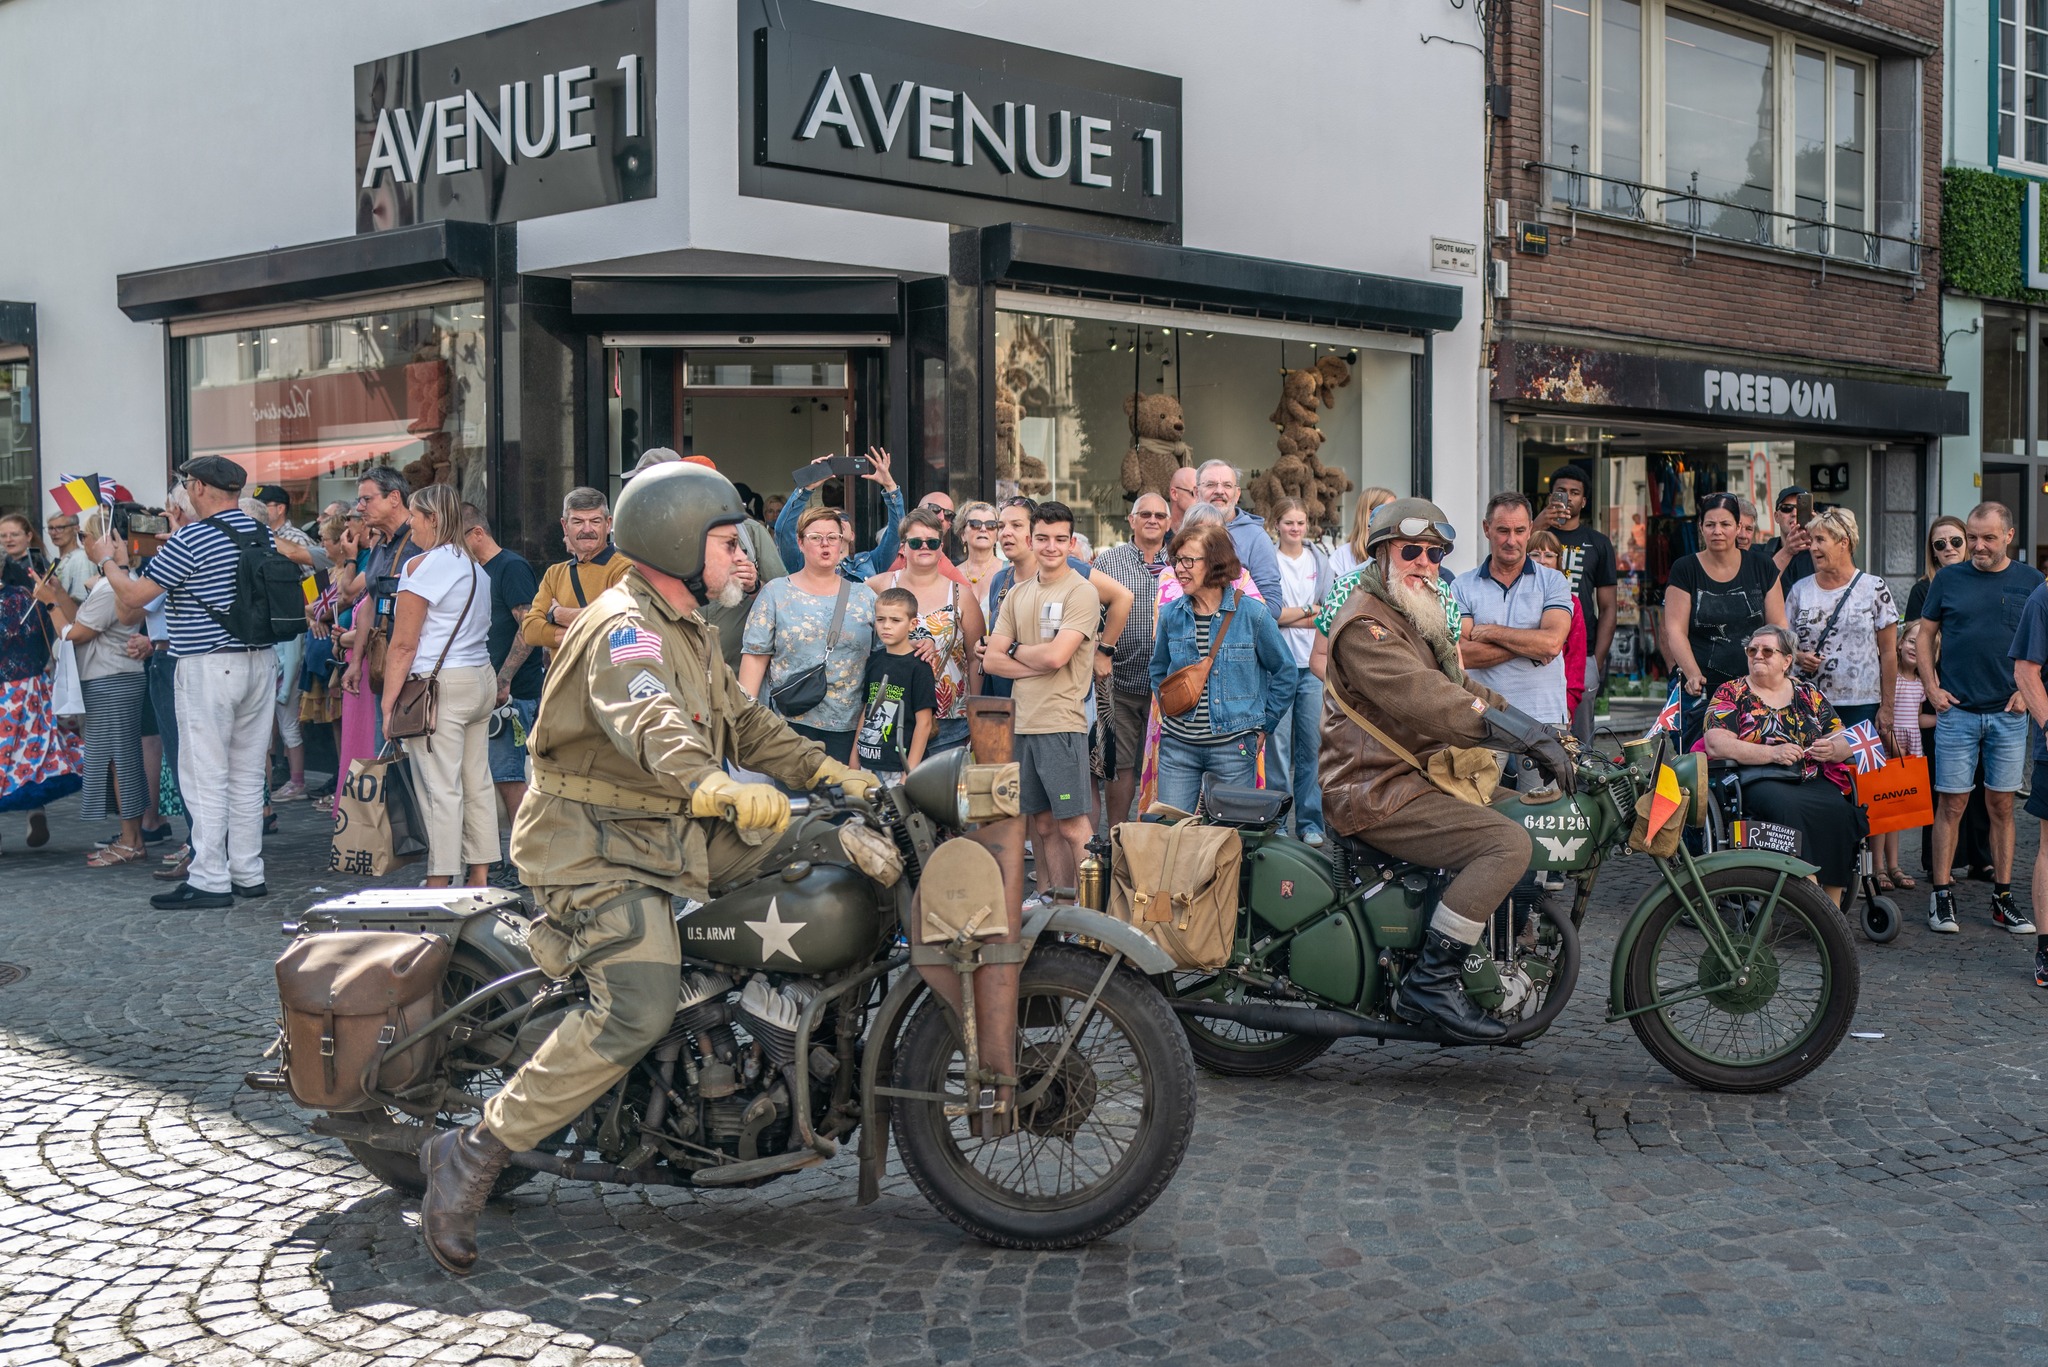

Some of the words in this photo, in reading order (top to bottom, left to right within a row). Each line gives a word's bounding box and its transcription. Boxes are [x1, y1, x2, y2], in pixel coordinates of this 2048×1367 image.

[362, 65, 592, 188] AVENUE
[616, 54, 638, 137] 1
[801, 66, 1112, 188] AVENUE
[1140, 128, 1162, 196] 1
[1435, 243, 1454, 253] GROTE
[1455, 246, 1475, 256] MARKT
[1704, 369, 1837, 420] FREEDOM
[1873, 787, 1918, 802] CANVAS
[1524, 815, 1591, 831] 6421261
[1771, 824, 1796, 836] BELGIAN
[1766, 830, 1795, 841] INFANTRY
[1769, 837, 1795, 848] BRIGADE
[687, 926, 706, 941] U.S.
[706, 926, 736, 941] ARMY
